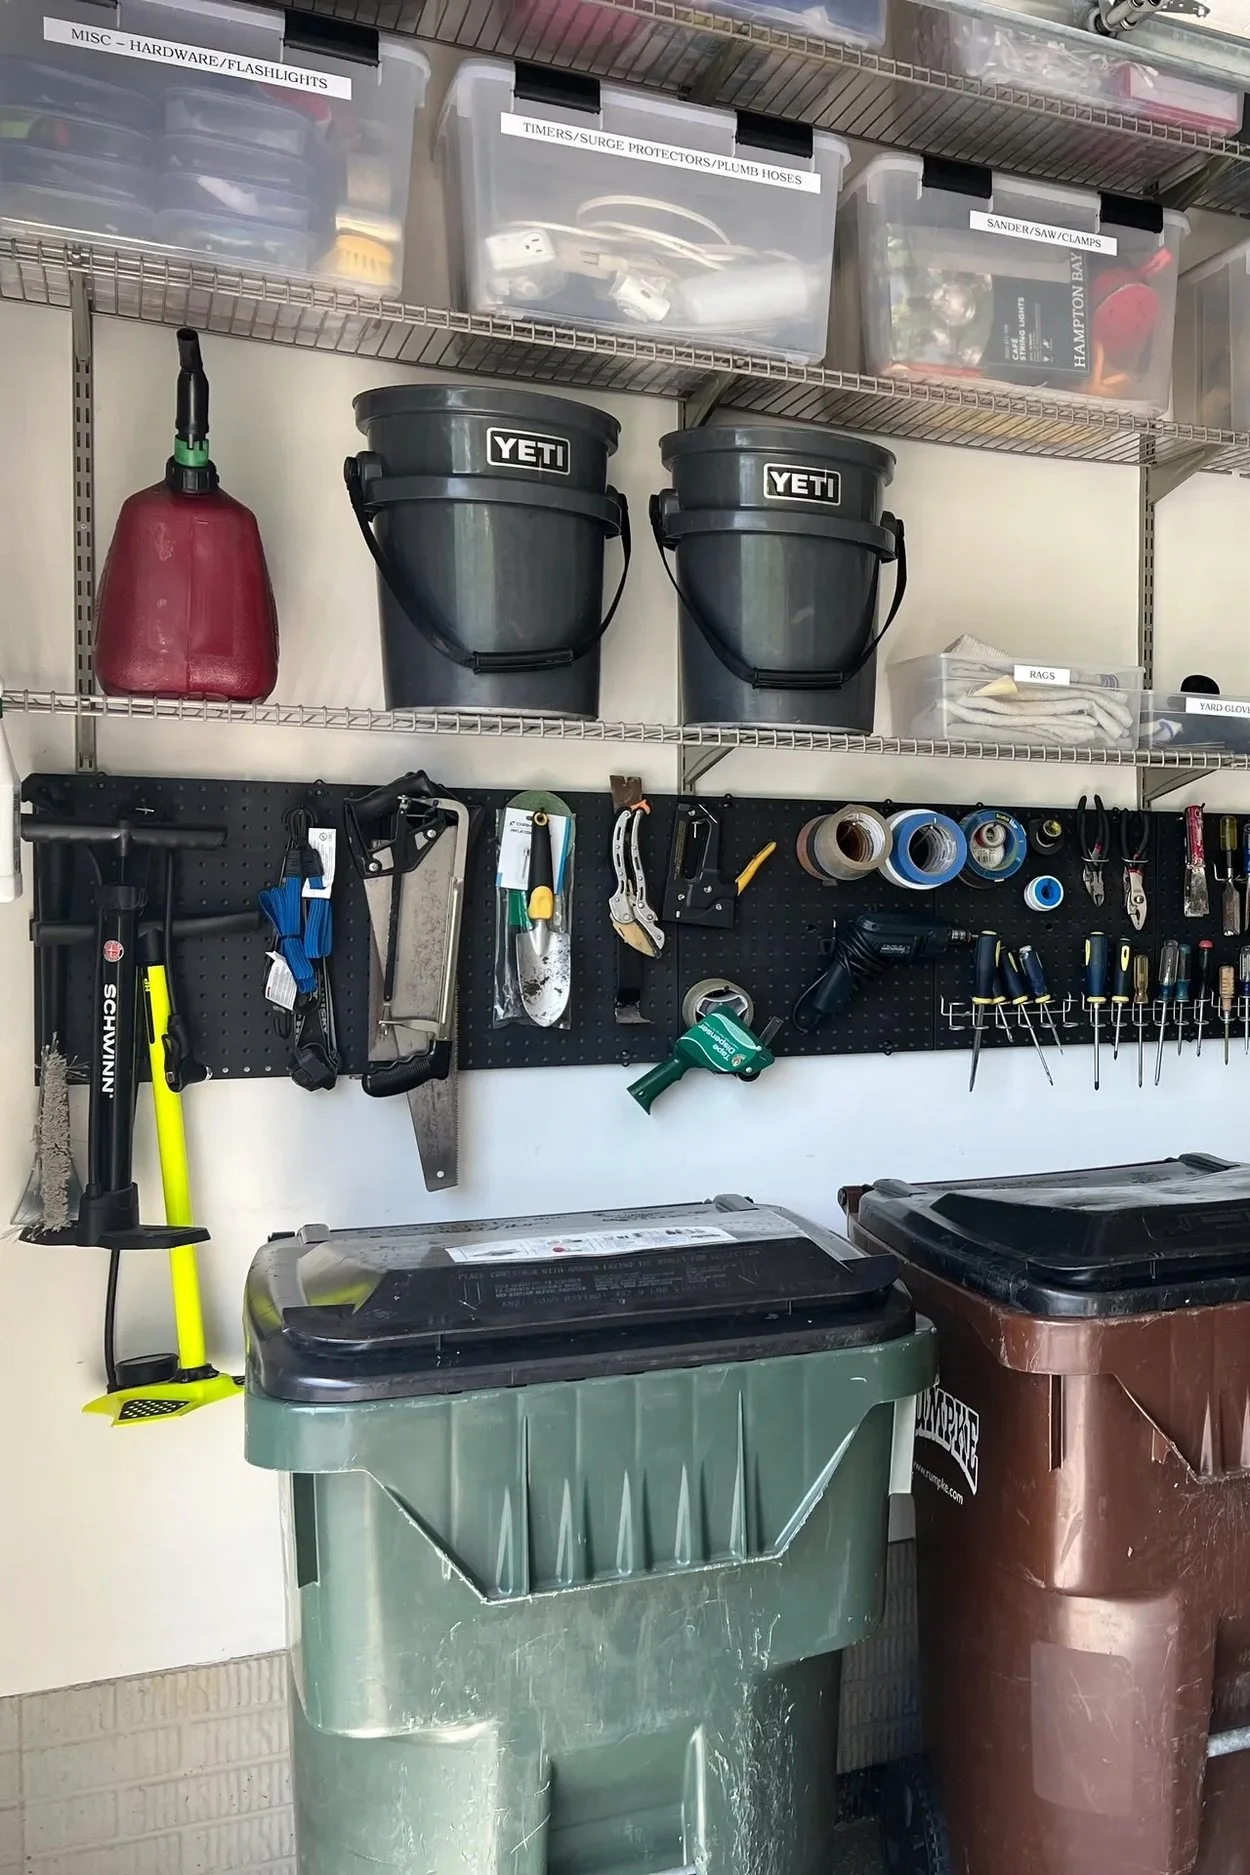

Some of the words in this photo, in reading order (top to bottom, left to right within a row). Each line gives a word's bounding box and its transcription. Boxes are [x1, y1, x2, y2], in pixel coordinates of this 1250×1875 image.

[71, 27, 111, 46] MISC
[130, 39, 327, 89] HARDWARE/FLASHLIGHTS
[522, 122, 624, 150] TIMERS/SURGE
[629, 143, 759, 177] PROTECTORS/PLUMB
[762, 169, 802, 185] HOSES
[987, 218, 1102, 248] SANDER/SAW/CLAMPS
[1070, 252, 1083, 281] BAY
[1072, 285, 1086, 368] HAMPTON
[493, 436, 564, 467] YETI
[768, 470, 834, 498] YETI
[1029, 669, 1056, 682] RAGS
[1199, 702, 1224, 713] YARD
[102, 983, 117, 1093] SCHWINN
[698, 1024, 736, 1054] Dispenser
[712, 1044, 731, 1062] Tape
[914, 1386, 980, 1496] UMPKE
